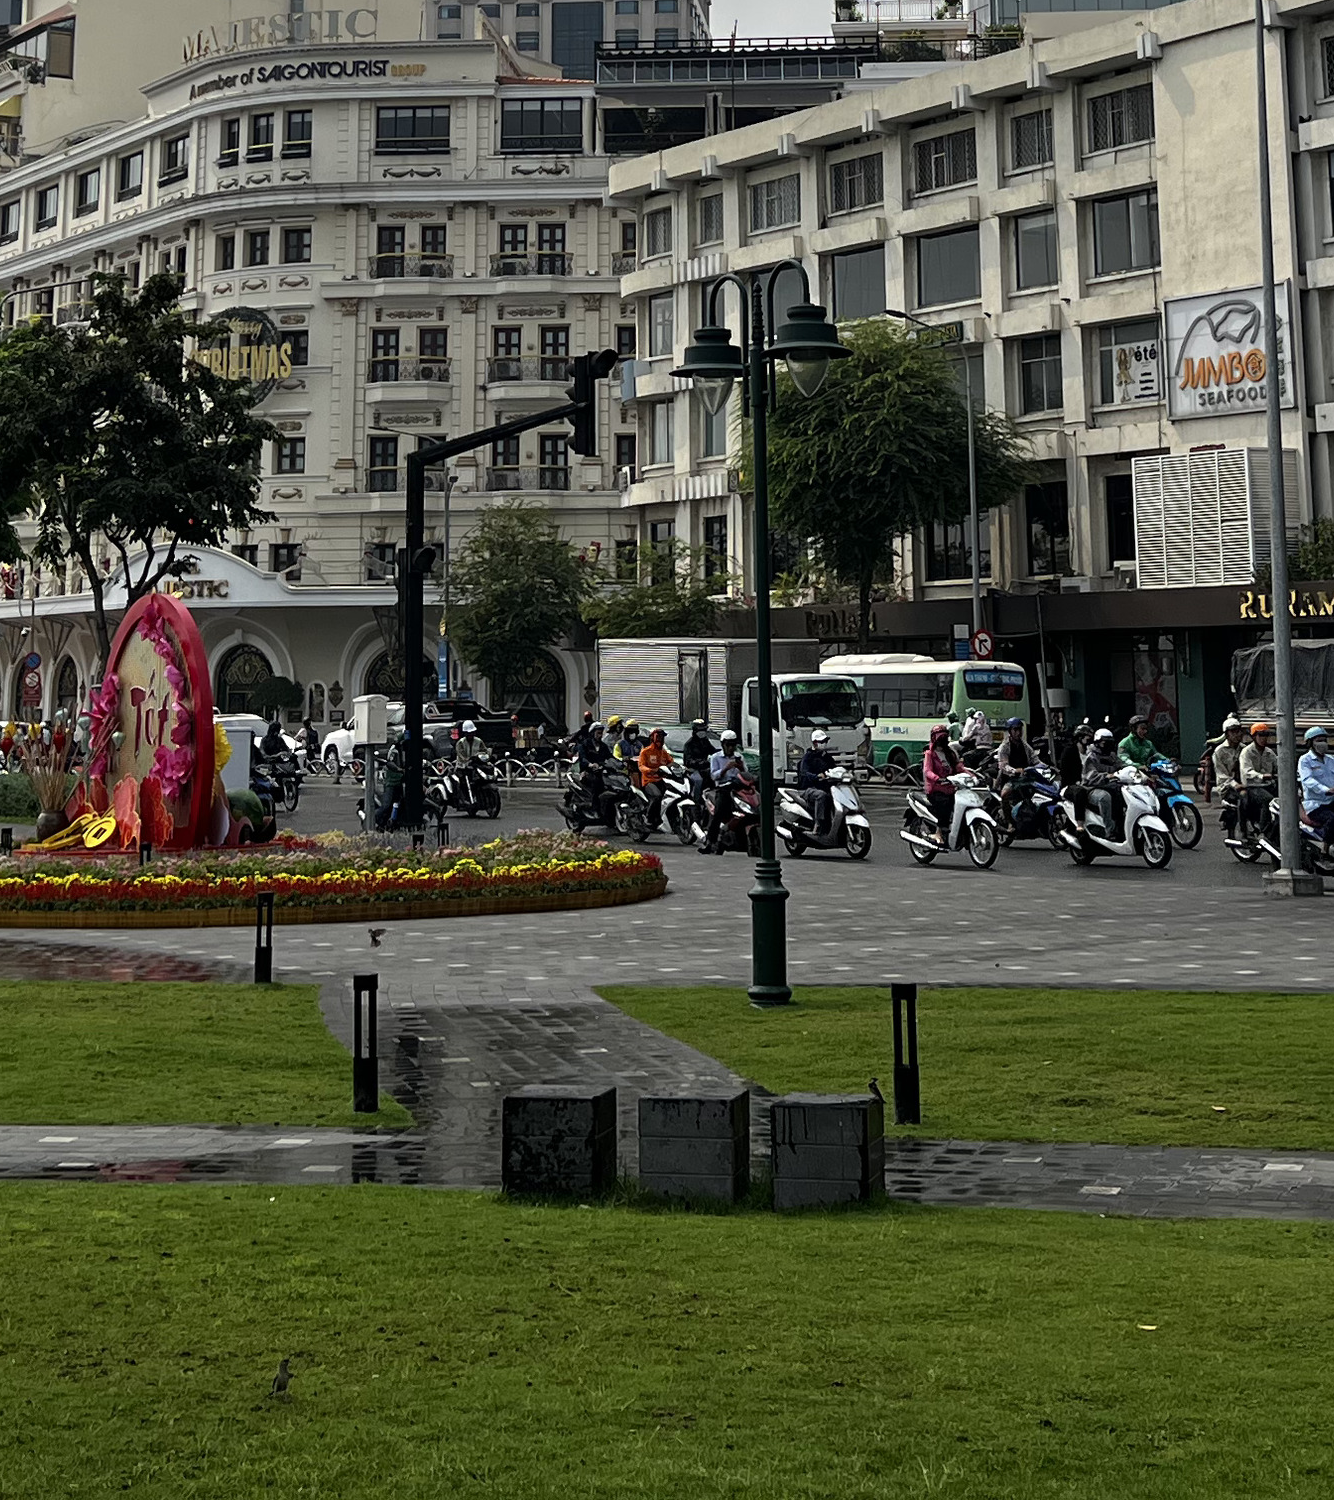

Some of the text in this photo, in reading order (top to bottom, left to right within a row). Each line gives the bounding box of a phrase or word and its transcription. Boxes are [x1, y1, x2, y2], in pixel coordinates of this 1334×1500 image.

[181, 8, 378, 65] MAJESTIC
[189, 84, 197, 101] A
[240, 67, 255, 86] of
[257, 60, 390, 83] SAIGONTOURIST
[1179, 348, 1266, 390] JUMBO
[1198, 385, 1267, 406] SEAFOOD
